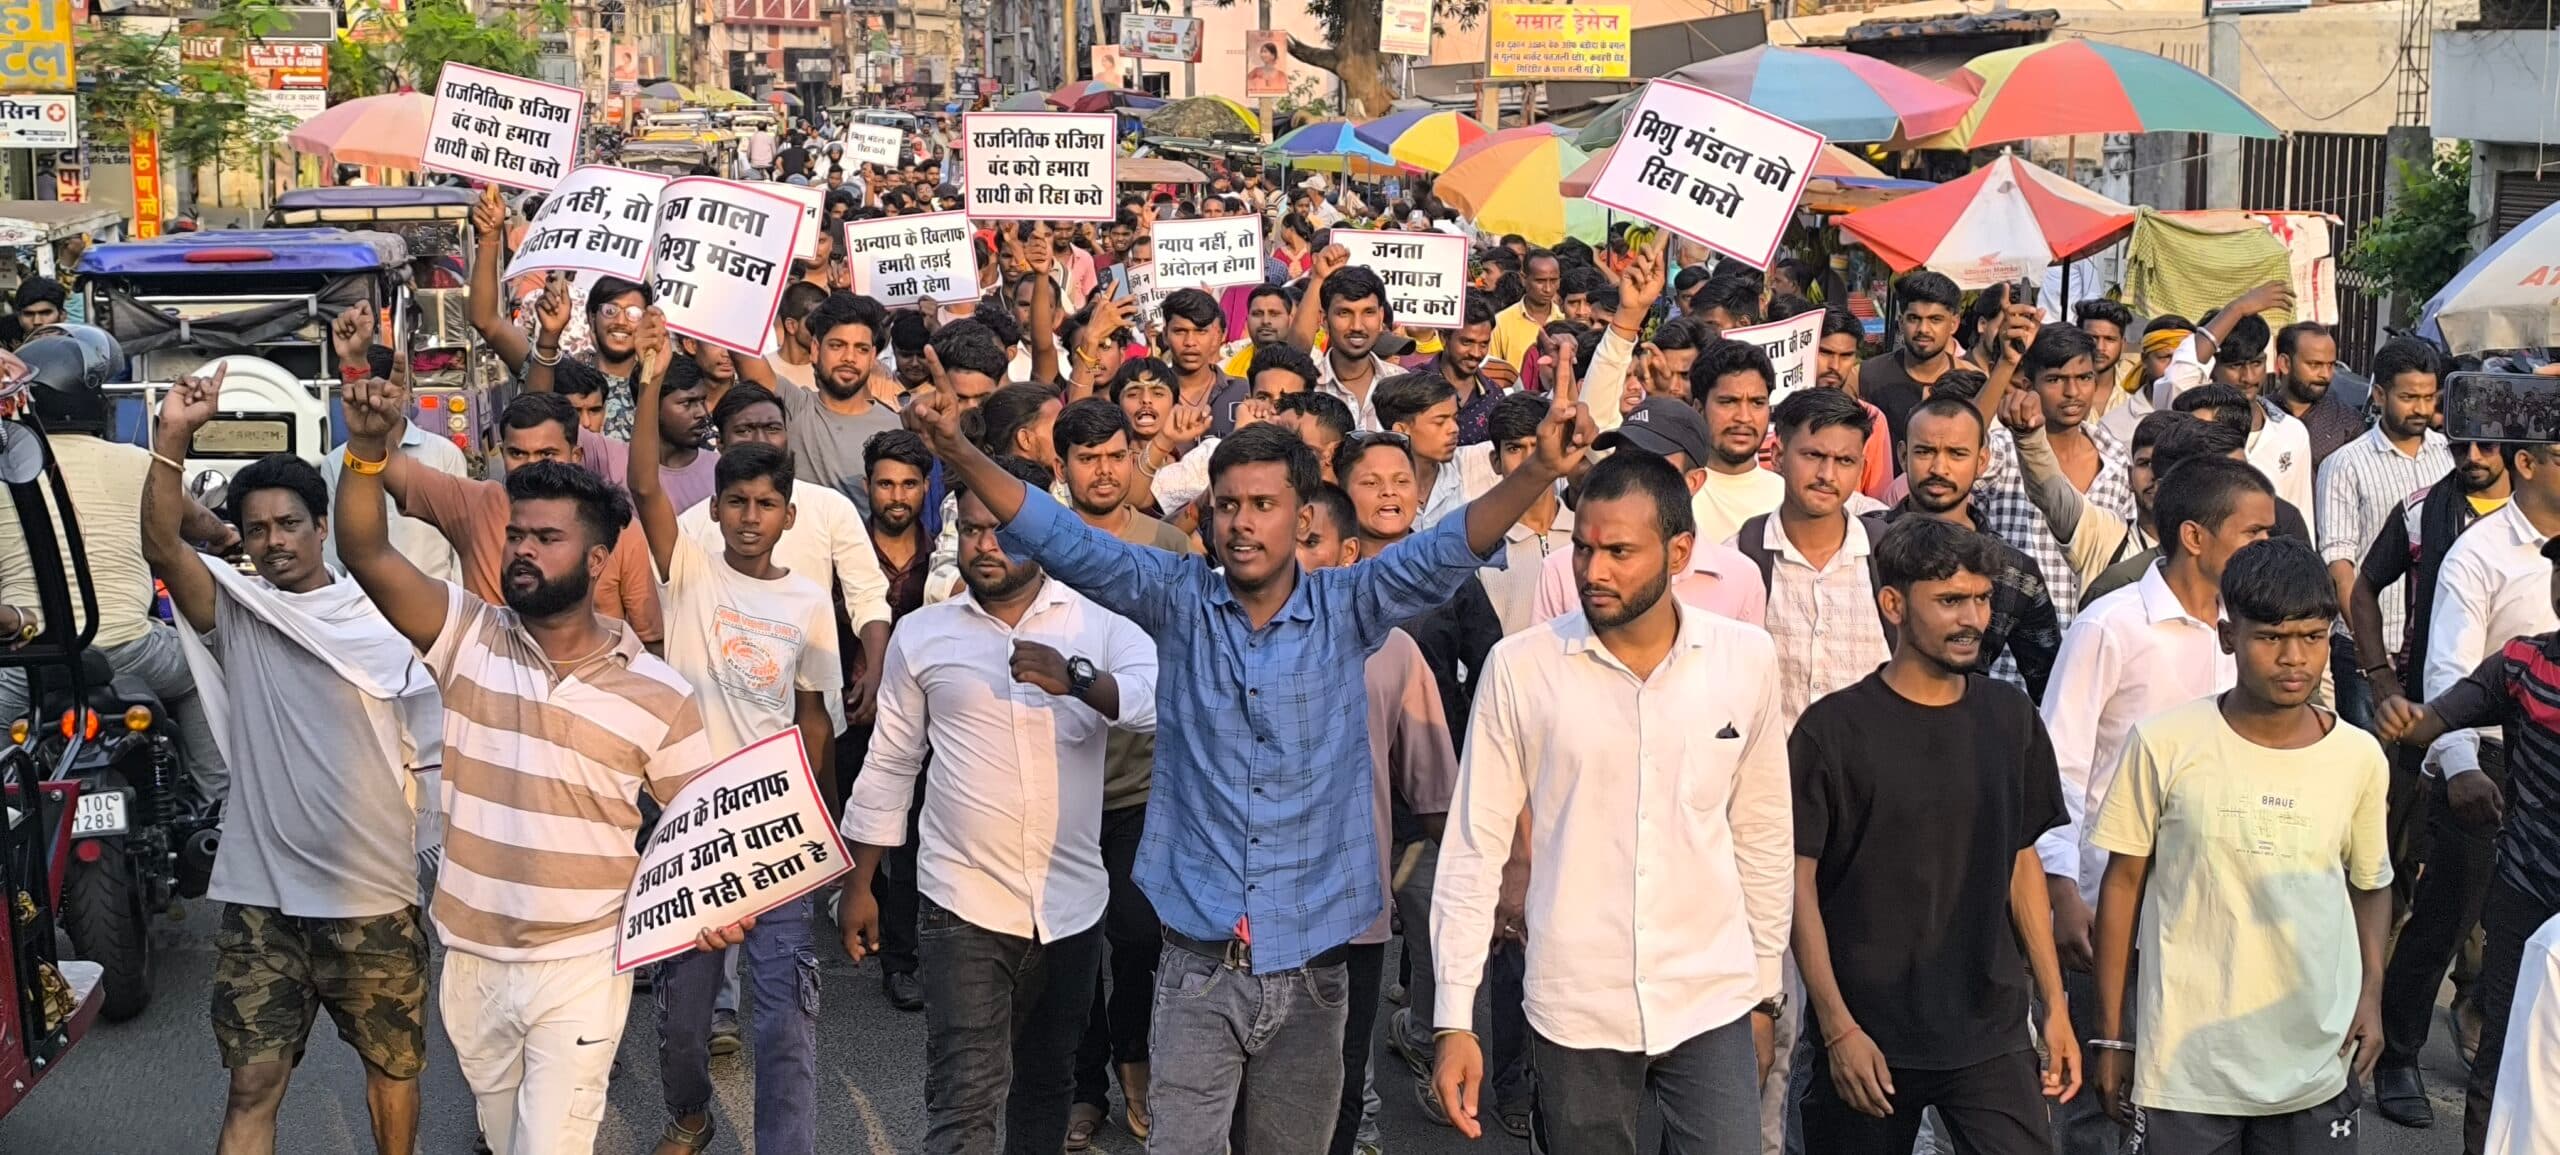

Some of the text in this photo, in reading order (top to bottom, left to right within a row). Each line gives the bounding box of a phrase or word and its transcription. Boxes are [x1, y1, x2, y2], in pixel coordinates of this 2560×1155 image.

[1514, 13, 1565, 32] सम्राट
[0, 42, 67, 77] टल
[445, 81, 572, 124] राजनितिक सजिश
[474, 115, 502, 138] करो
[505, 124, 551, 149] हमारा
[973, 127, 1105, 150] राजनितिक सजिश
[434, 136, 561, 179] साथी को रिहा करो
[1013, 155, 1041, 177] करो
[1046, 160, 1090, 178] हमारा
[1633, 110, 1796, 193] मिशु मंडल को
[976, 183, 1103, 205] साथी को रिहा करो
[1637, 155, 1744, 219] रिहा करो
[566, 186, 612, 220] नहीं,
[623, 194, 653, 223] तो
[697, 198, 769, 238] ताला
[586, 224, 643, 259] होगा
[854, 227, 965, 253] अन्याय के खिलाफ
[1158, 229, 1255, 253] न्याय नहीं, तो
[1372, 242, 1424, 260] जनता
[659, 233, 776, 286] मिशु मंडल
[877, 248, 951, 274] हमारी लड़ाई
[1159, 255, 1256, 277] अंदोलन होगा
[886, 275, 950, 296] जारी रहेगा
[1380, 269, 1443, 288] आवाज
[1392, 292, 1459, 316] बंद करों
[1762, 339, 1786, 359] ता
[693, 798, 709, 827] के
[713, 770, 790, 819] खिलाफ
[636, 812, 804, 897] अवाज उठाने वाला
[627, 840, 829, 940] अपराधी नही होता है
